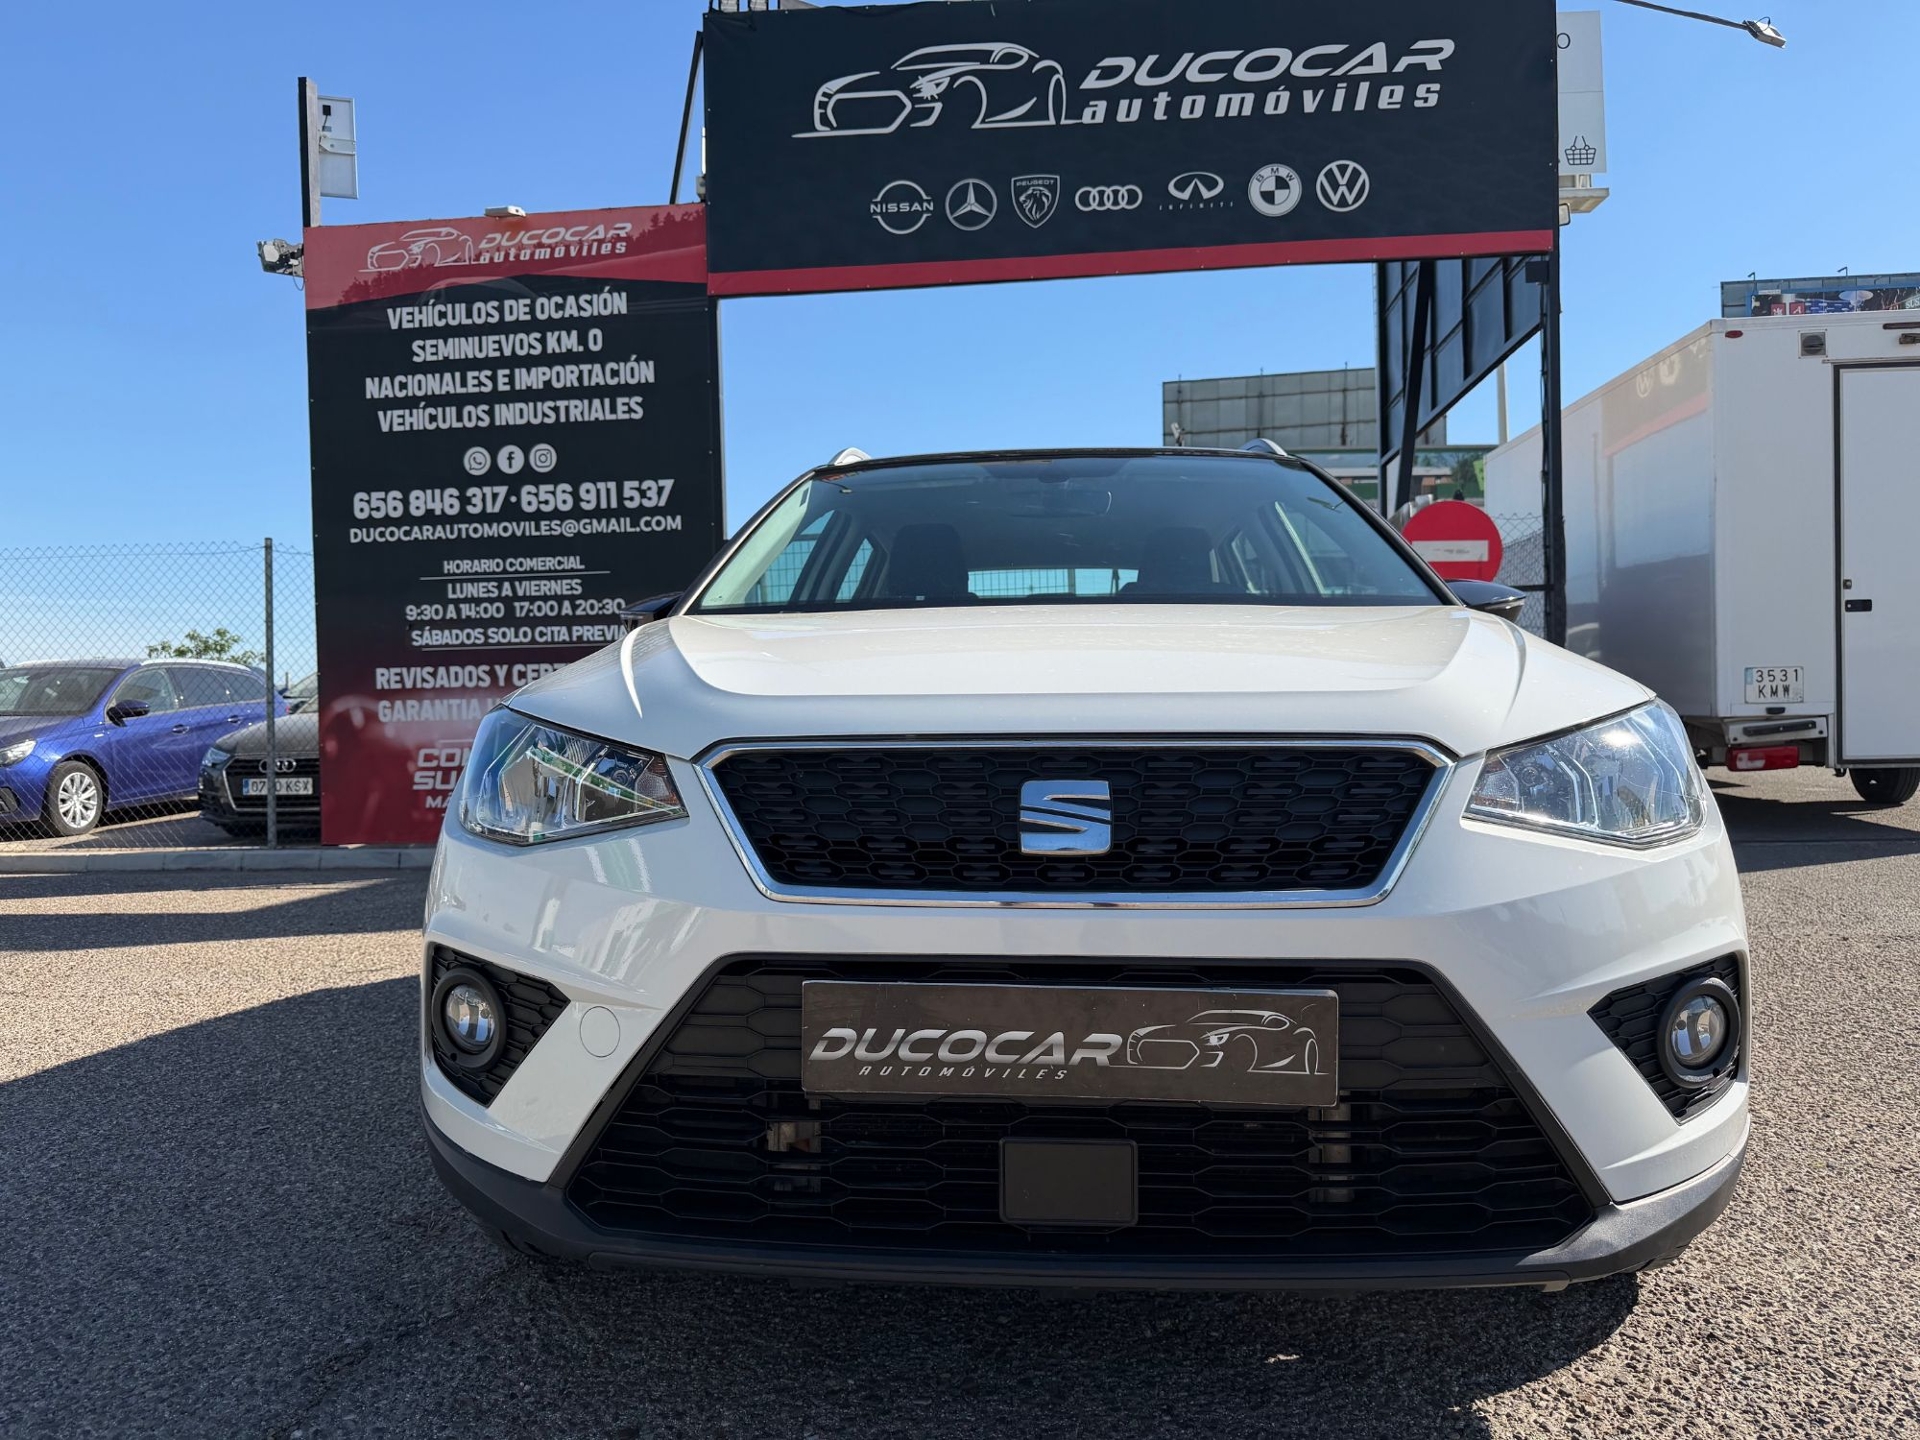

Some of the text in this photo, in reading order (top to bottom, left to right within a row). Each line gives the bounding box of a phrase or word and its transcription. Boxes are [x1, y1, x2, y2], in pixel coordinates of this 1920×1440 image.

[1079, 38, 1455, 89] DUCOCAR
[1082, 81, 1441, 124] automóviles
[870, 201, 934, 213] NISSAN
[478, 222, 632, 249] DUCOCAR
[387, 286, 628, 330] VEHÍCULOS DE OCASIÓN
[411, 332, 542, 363] SEMINUEVOS
[546, 330, 584, 354] KM.
[365, 354, 655, 399] NACIONALES E IMPORTACIÓN
[378, 396, 643, 432] VEHÍCULOS INDUSTRIALES
[353, 490, 404, 519] 656
[408, 487, 460, 516] 846
[579, 481, 618, 510] 911
[622, 478, 675, 508] 537
[350, 515, 682, 543] DUCOCARAUTOMOVILES@GMAIL.COM
[443, 556, 585, 574] HORARIO COMERCIAL
[447, 579, 583, 599] LUNES A VIERNES
[405, 598, 627, 621] 9:30 A 14:00 17:00 A 20:30
[411, 625, 628, 646] SÁBADOS SOLO CITA PREVIA
[375, 665, 491, 690] REVISADOS
[493, 664, 509, 687] Y
[1756, 669, 1798, 683] 3531
[1758, 684, 1790, 698] KMW
[251, 780, 309, 792] 070 KSX
[808, 1027, 1123, 1066] DUCOCAR
[859, 1065, 1068, 1080] AUTOMÓVILES
